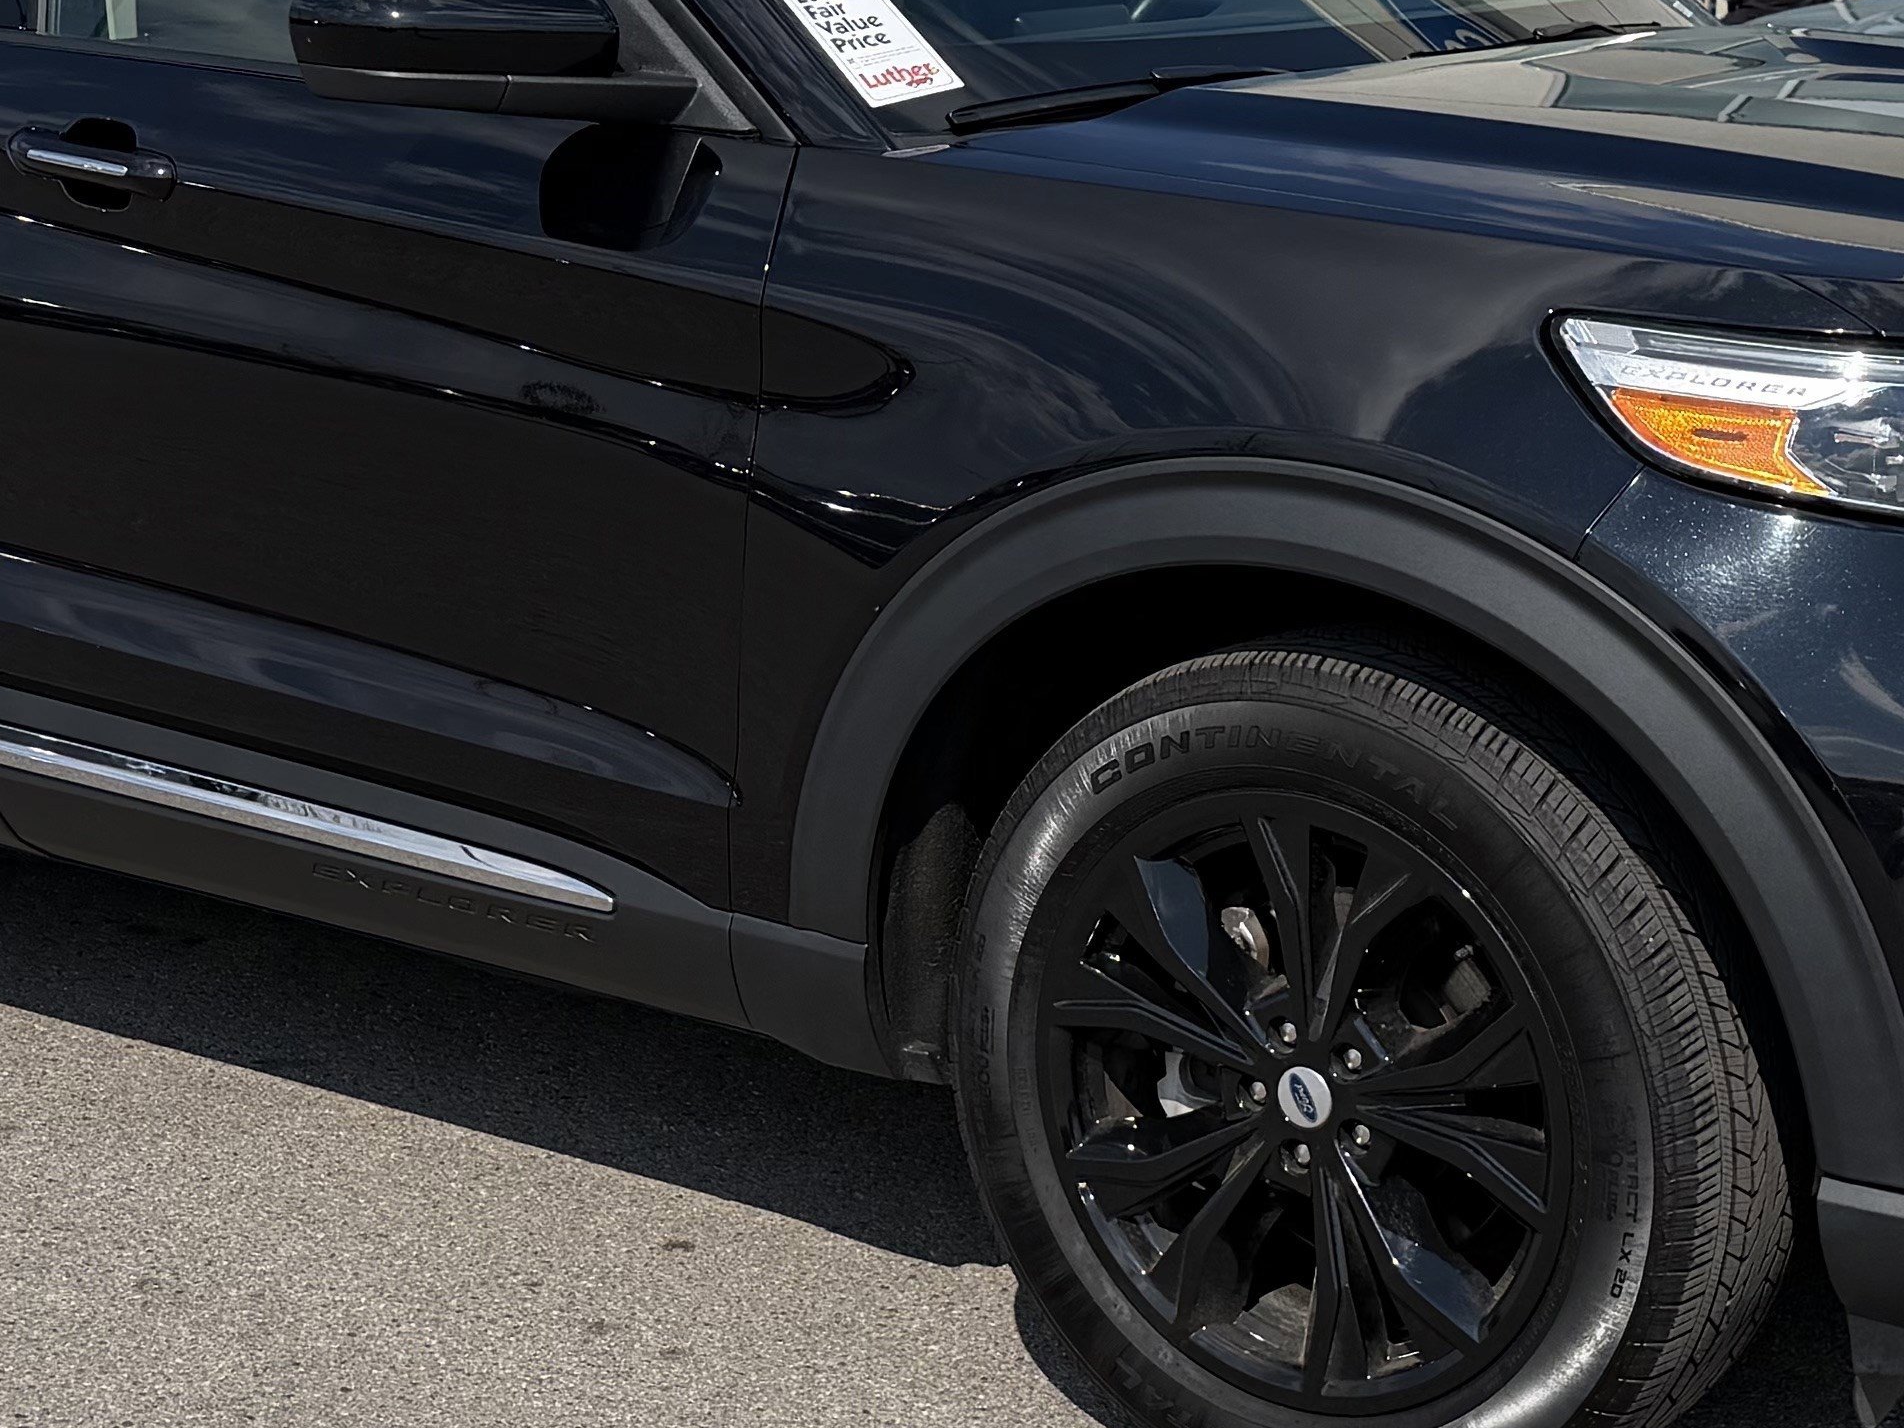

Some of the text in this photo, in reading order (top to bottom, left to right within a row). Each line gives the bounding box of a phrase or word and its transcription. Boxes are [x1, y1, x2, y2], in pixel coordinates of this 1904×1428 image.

[803, 1, 846, 20] Fair
[815, 15, 883, 35] Value
[830, 32, 891, 53] Price
[859, 63, 933, 89] Luther
[1621, 363, 1807, 397] EXPLORER
[1090, 724, 1459, 832] CONTINENTAL
[312, 862, 596, 943] EXPLORER
